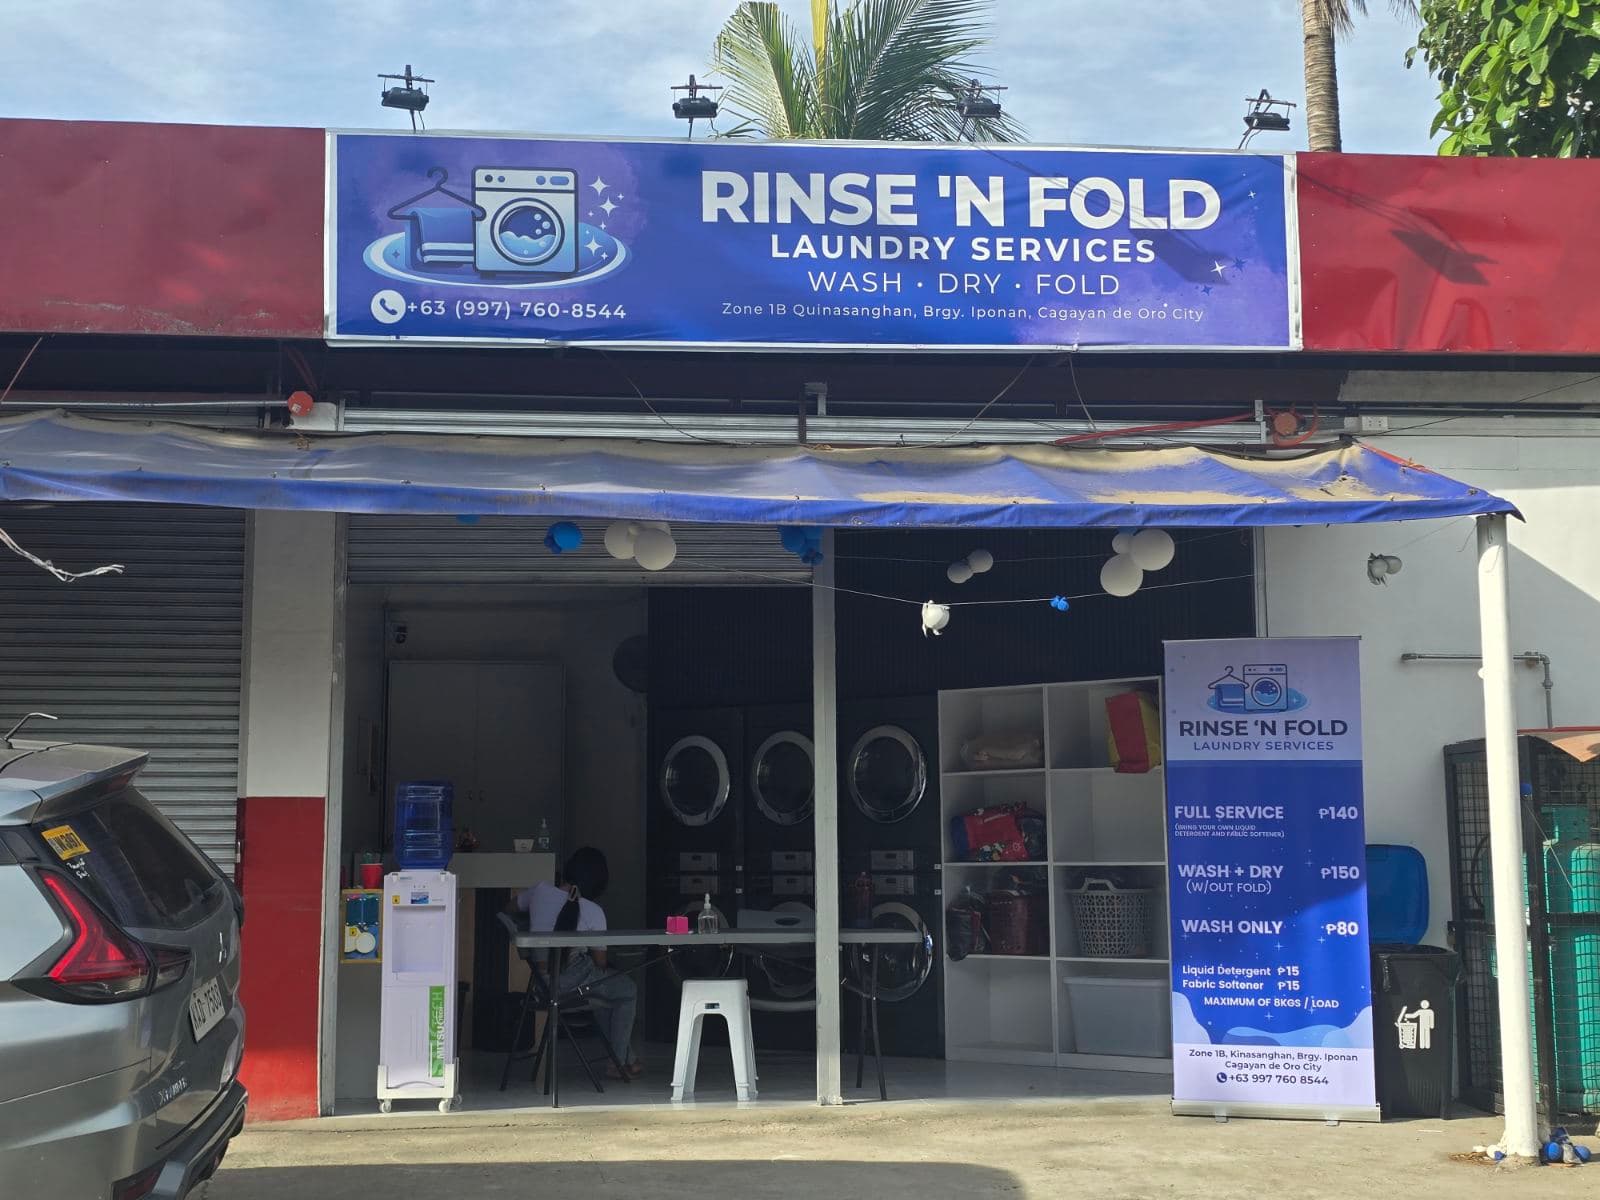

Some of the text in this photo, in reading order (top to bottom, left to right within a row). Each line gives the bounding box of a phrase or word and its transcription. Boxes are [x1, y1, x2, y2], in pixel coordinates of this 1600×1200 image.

[702, 171, 917, 226] RINSE
[1030, 177, 1221, 230] FOLD
[772, 235, 1155, 263] LAUNDRY SERVICES
[808, 271, 1119, 295] WASH DRY FOLD
[406, 300, 626, 320] +63 (997) 760-8544
[722, 303, 1203, 322] Zone 1B Quinasanghan, Brgy. Iponan, Cagayan de Oro City
[1179, 721, 1248, 736] RINSE
[1285, 720, 1348, 735] FOLD
[1194, 741, 1334, 750] LAUNDRY SERVICES
[1175, 806, 1210, 818] FULL
[1215, 806, 1284, 819] SERVICE
[1178, 865, 1229, 877] WASH
[1250, 865, 1283, 878] DRY
[1186, 881, 1272, 894] (W/OUT FOLD)
[1182, 920, 1233, 933] WASH
[1238, 921, 1283, 934] ONLY
[1183, 965, 1214, 976] Liquid
[1218, 966, 1271, 978] Detergent
[1183, 980, 1215, 989] Fabric
[1219, 980, 1263, 989] Softener
[1204, 997, 1255, 1007] MAXIMUM
[1258, 998, 1271, 1007] OF
[1274, 998, 1301, 1008] 8KGS
[1312, 1000, 1339, 1008] LOAD
[1215, 1050, 1228, 1059] 1B,
[1231, 1050, 1294, 1061] Kinasanghan,
[1297, 1052, 1322, 1061] Brgy.
[1325, 1053, 1358, 1062] Iponan
[1225, 1061, 1266, 1071] Cagayan
[1303, 1063, 1322, 1072] City
[1229, 1074, 1329, 1085] +63 997 760 8544
